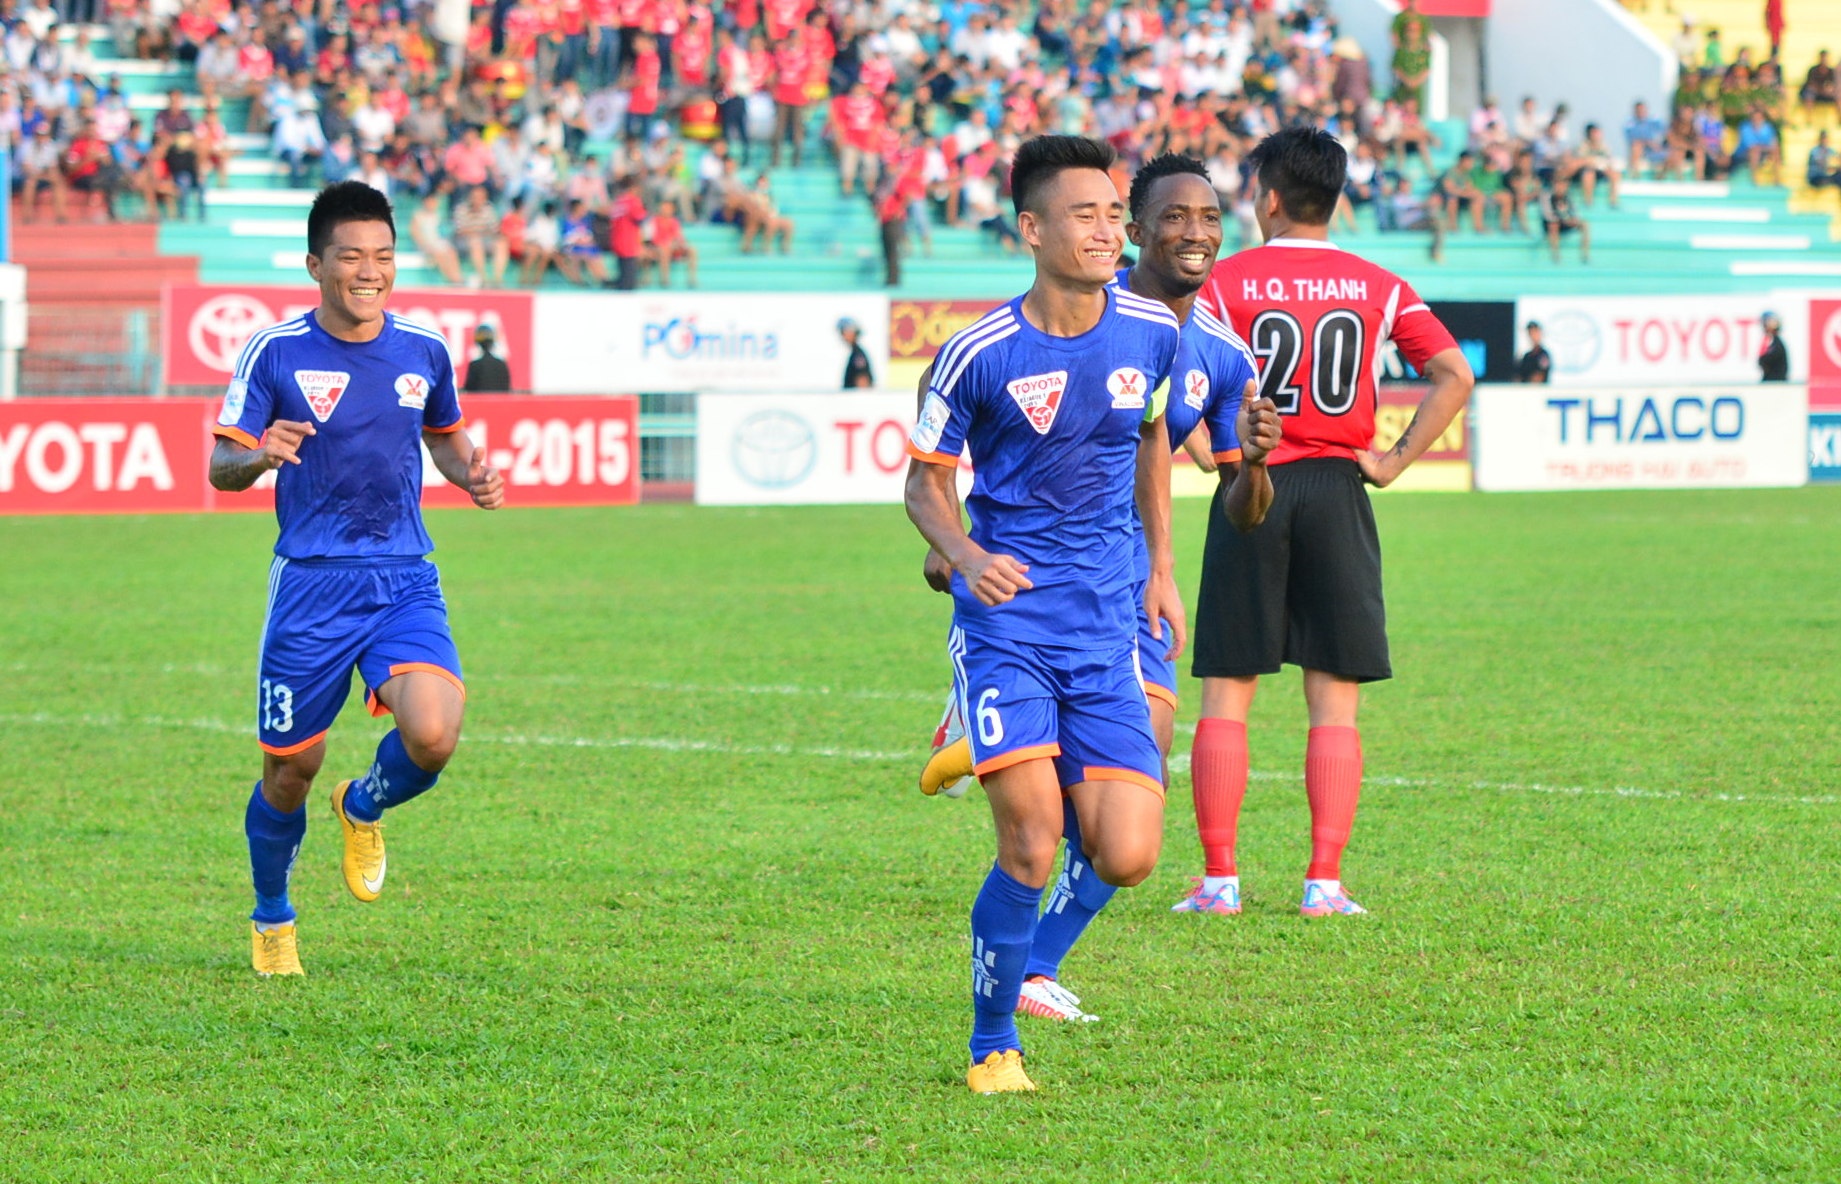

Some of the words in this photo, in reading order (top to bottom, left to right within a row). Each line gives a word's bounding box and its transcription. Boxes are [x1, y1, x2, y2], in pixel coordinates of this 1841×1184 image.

[1251, 308, 1366, 417] 20
[1612, 317, 1760, 363] TOYOT
[300, 374, 345, 385] TOYOTA
[1013, 376, 1063, 395] TOYOTA
[1546, 396, 1745, 443] THACO
[262, 679, 294, 733] 13
[976, 687, 1004, 747] 6
